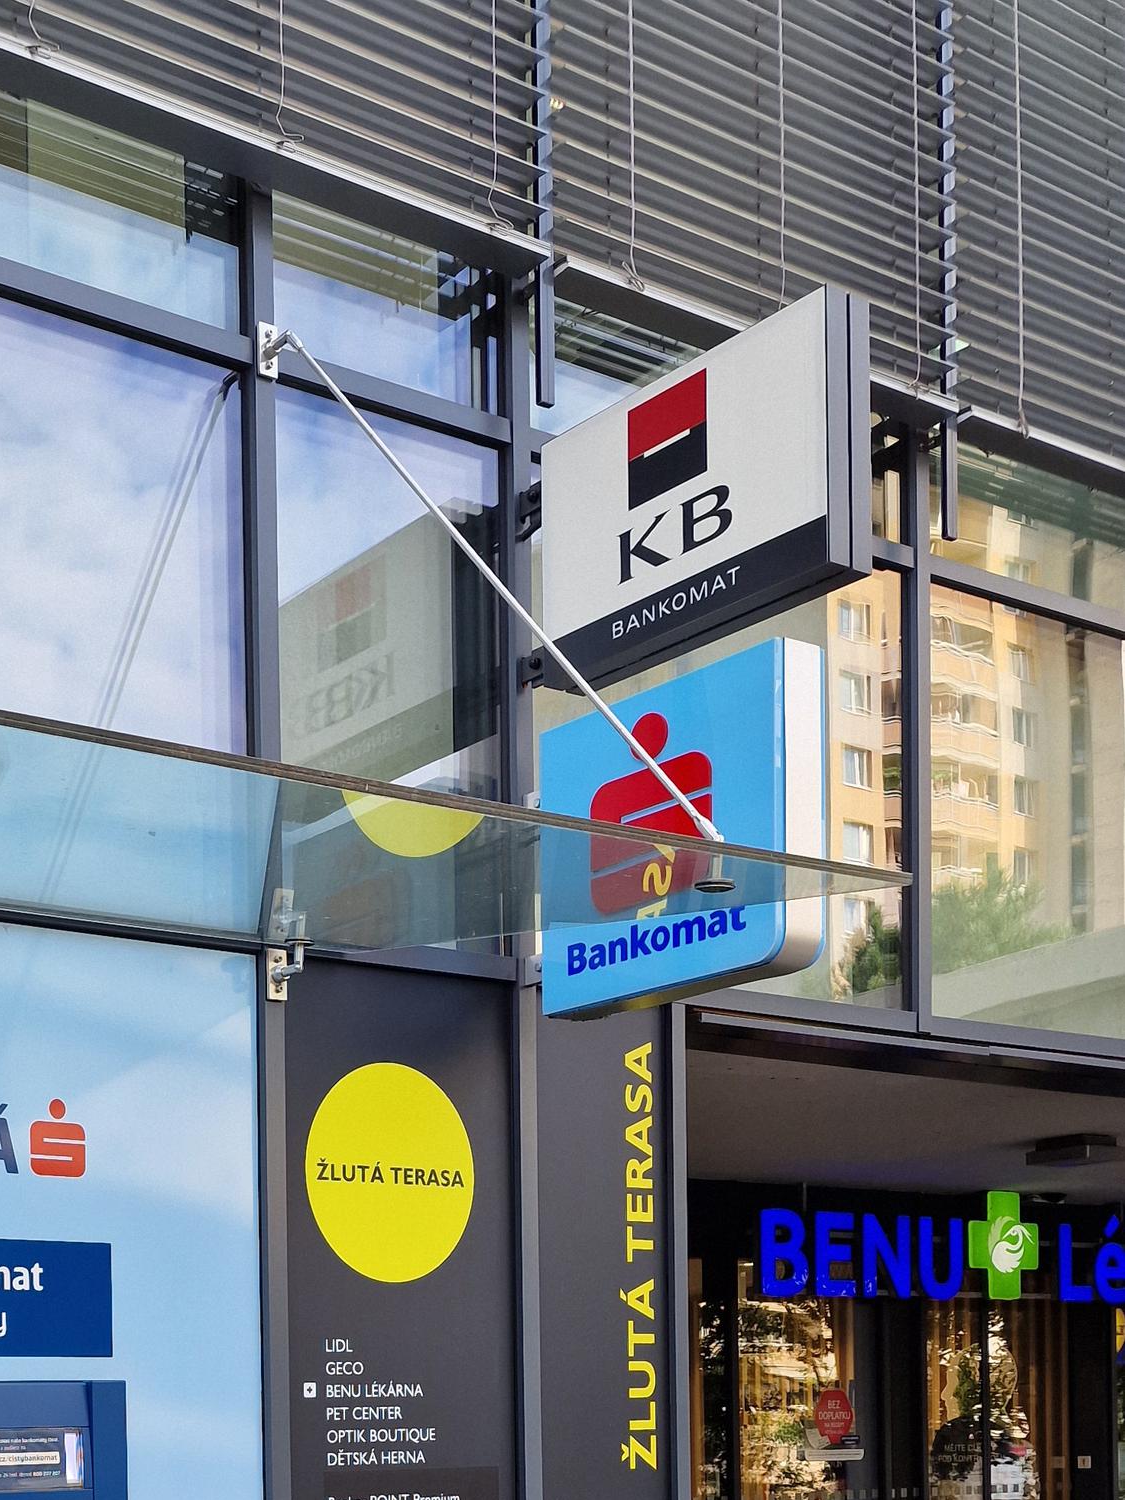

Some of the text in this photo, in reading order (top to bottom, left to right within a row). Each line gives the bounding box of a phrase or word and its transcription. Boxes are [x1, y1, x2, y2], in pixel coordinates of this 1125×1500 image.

[617, 484, 733, 585] KB
[611, 566, 740, 639] BANKOMAT
[566, 905, 747, 977] Bankomat
[623, 1041, 655, 1263] TERASA
[316, 1158, 464, 1188] ŽLUTÁ TERASA
[759, 1208, 964, 1301] BENU
[325, 1339, 353, 1353] LIDL
[325, 1361, 364, 1375] GECO
[619, 1278, 658, 1470] ŽLUTÁ
[326, 1380, 424, 1398] BENU LÉKÁRNA
[326, 1406, 403, 1421] PET CENTER
[818, 1411, 851, 1420] DOPLATKU
[327, 1427, 436, 1443] OPTIK BOUTIQUE
[327, 1449, 426, 1466] DĚTSKÁ HERNA
